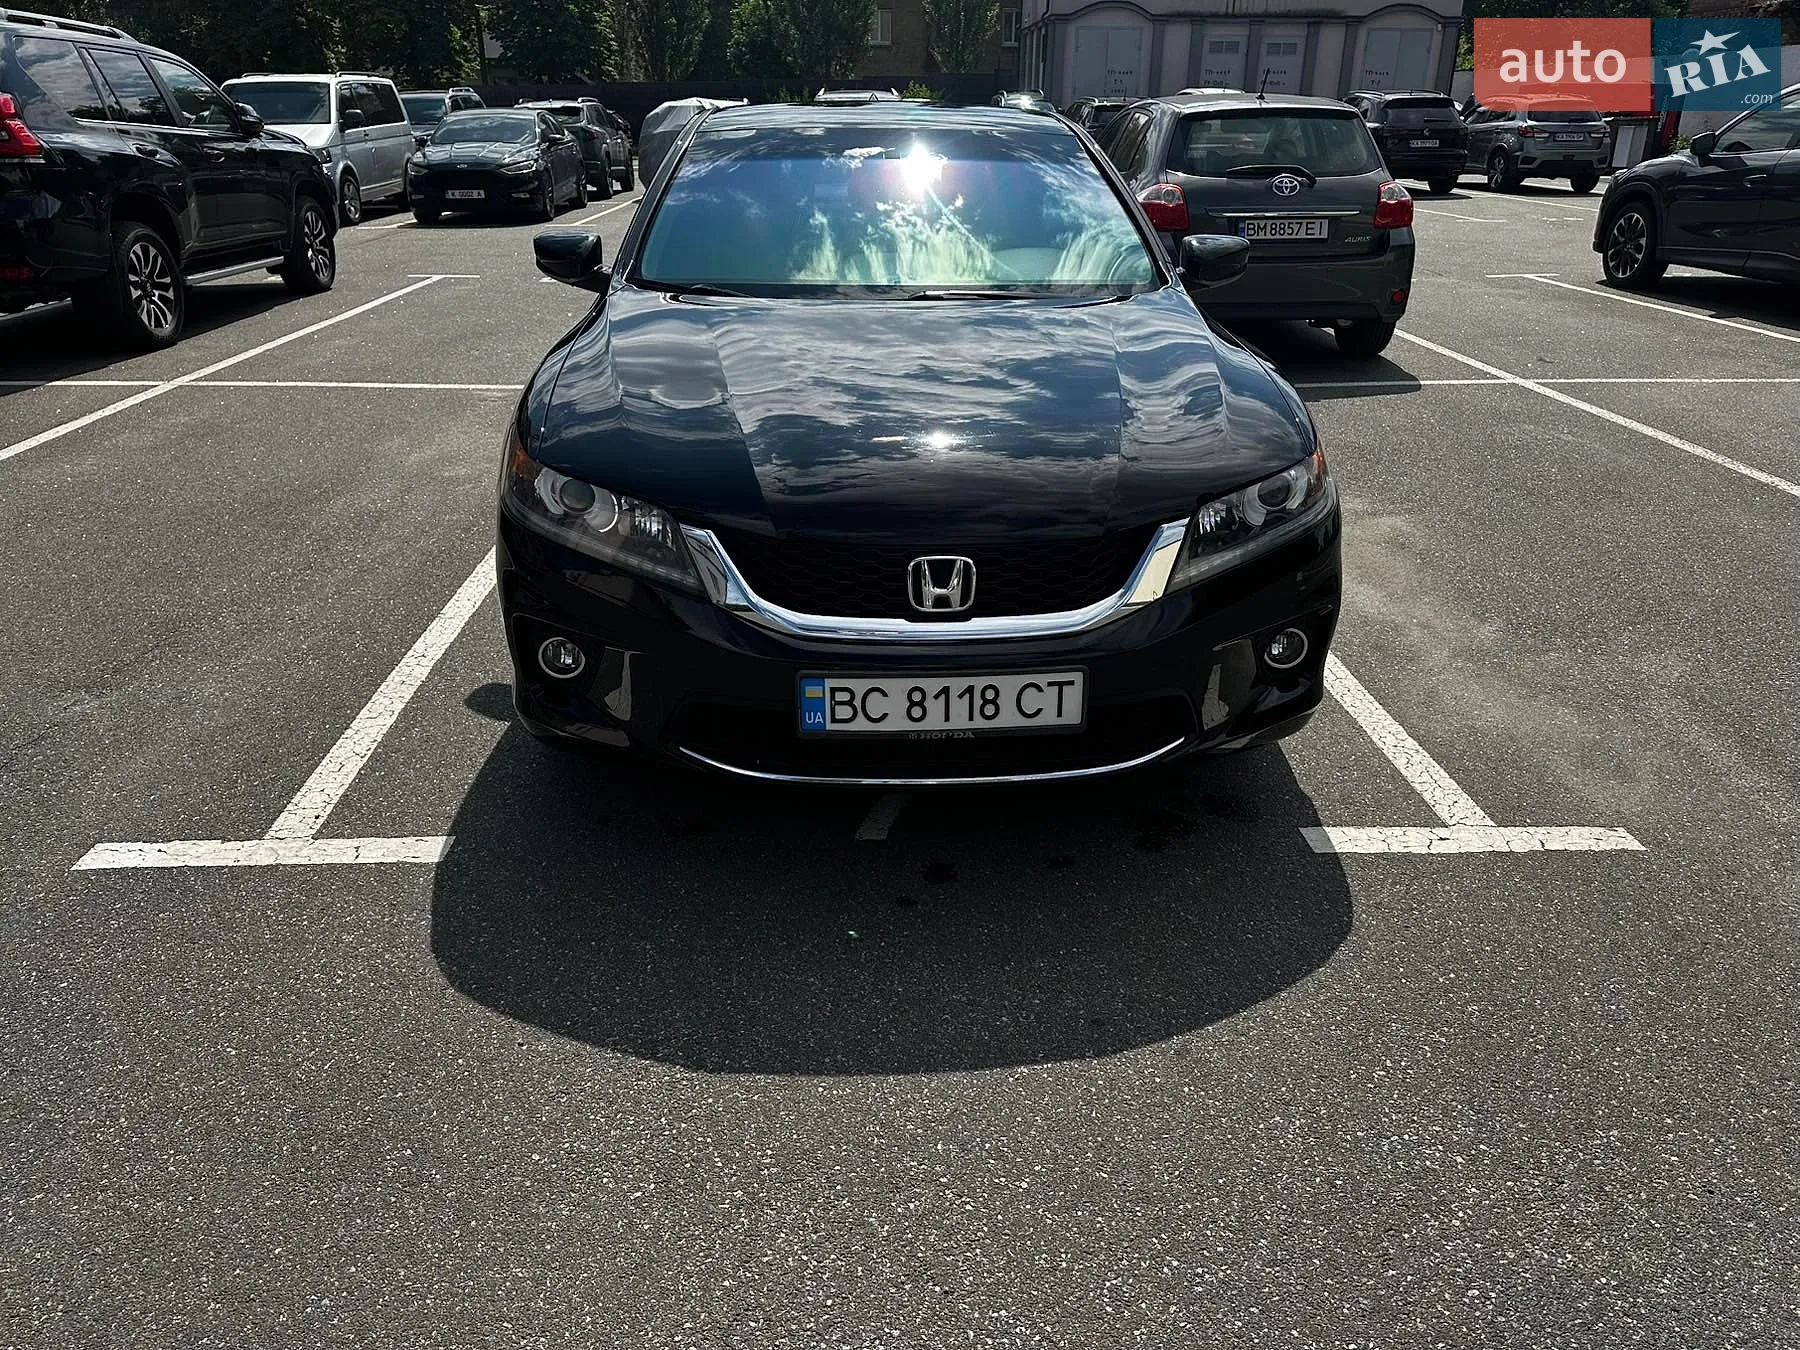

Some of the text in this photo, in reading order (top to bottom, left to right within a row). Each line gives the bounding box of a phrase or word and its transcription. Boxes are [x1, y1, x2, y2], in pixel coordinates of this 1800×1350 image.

[1246, 222, 1267, 237] BM
[1269, 222, 1303, 237] 8857
[1344, 235, 1371, 243] AURIS
[829, 679, 1075, 724] BC 8118 CT
[805, 712, 824, 724] UA
